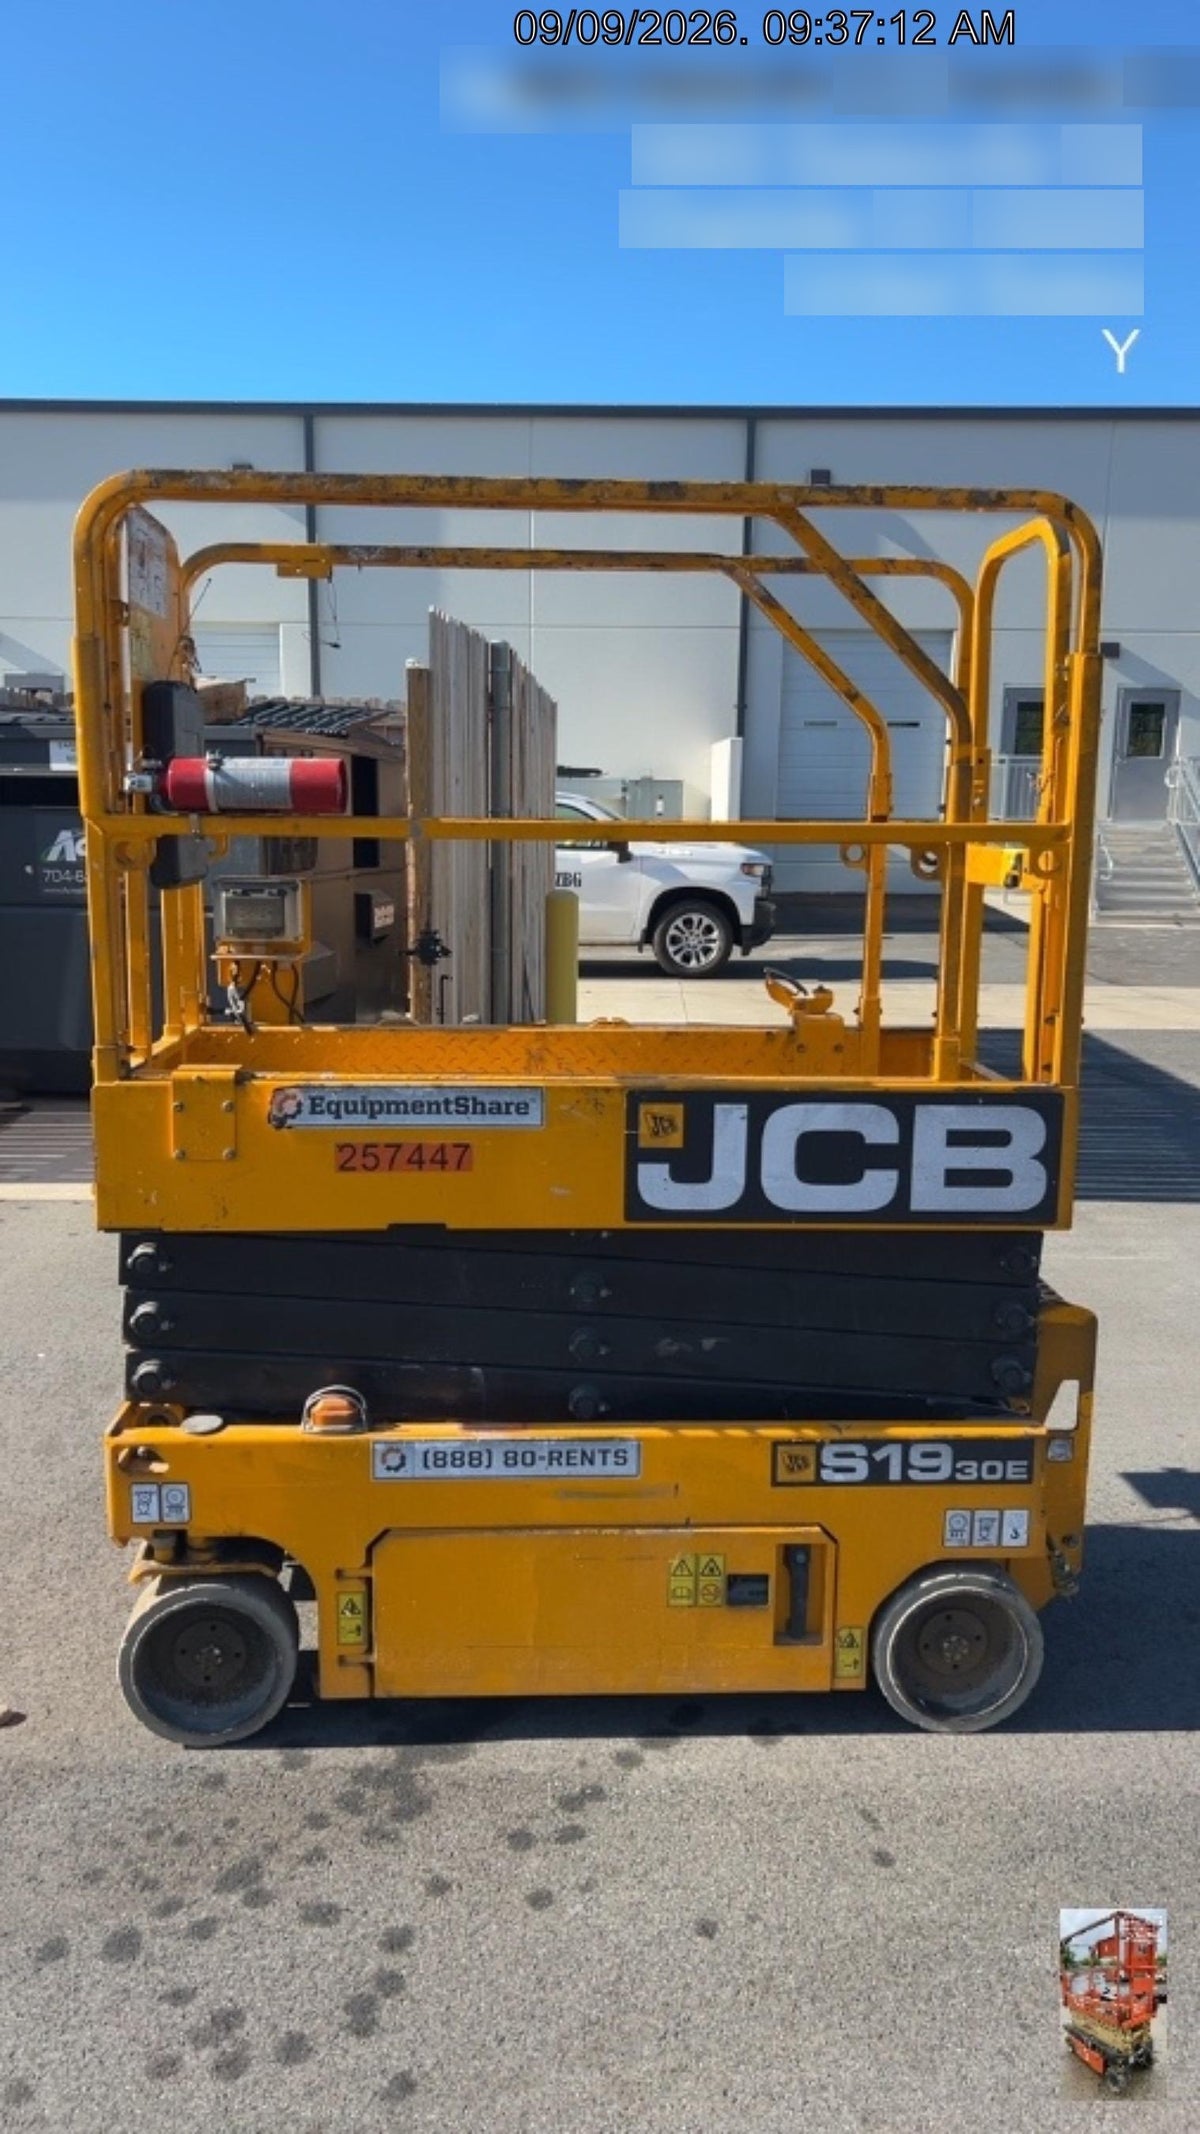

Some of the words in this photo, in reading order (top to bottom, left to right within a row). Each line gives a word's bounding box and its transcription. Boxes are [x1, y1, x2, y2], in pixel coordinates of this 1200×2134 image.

[308, 1096, 530, 1119] EquipmentShare
[337, 1143, 471, 1172] 257447
[637, 1103, 1048, 1213] JCB
[423, 1448, 493, 1468] (888)
[503, 1449, 628, 1468] 80-RENTS
